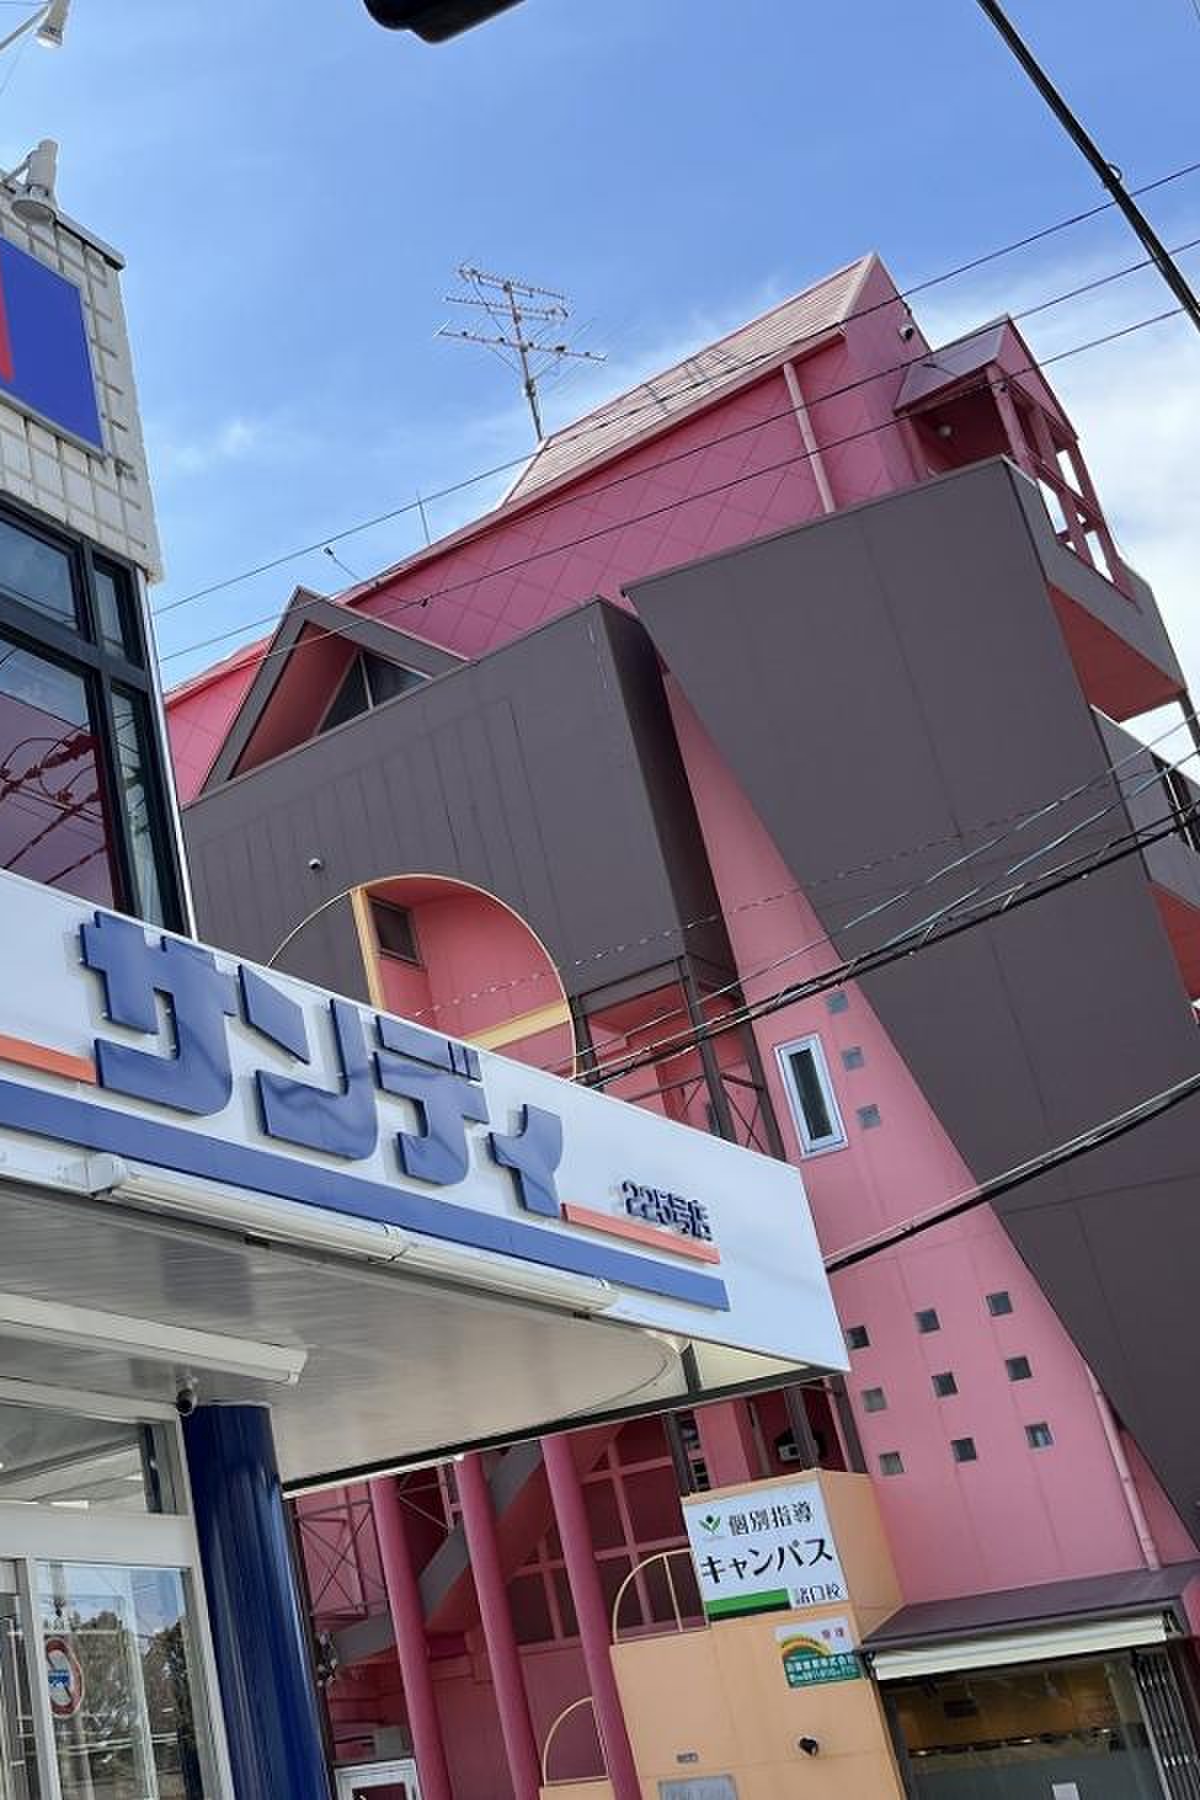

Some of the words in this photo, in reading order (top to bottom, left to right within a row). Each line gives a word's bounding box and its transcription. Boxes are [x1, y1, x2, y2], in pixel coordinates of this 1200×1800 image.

[80, 910, 563, 1217] サンディ
[728, 1500, 814, 1537] 個別指導
[700, 1538, 834, 1585] キャンパス
